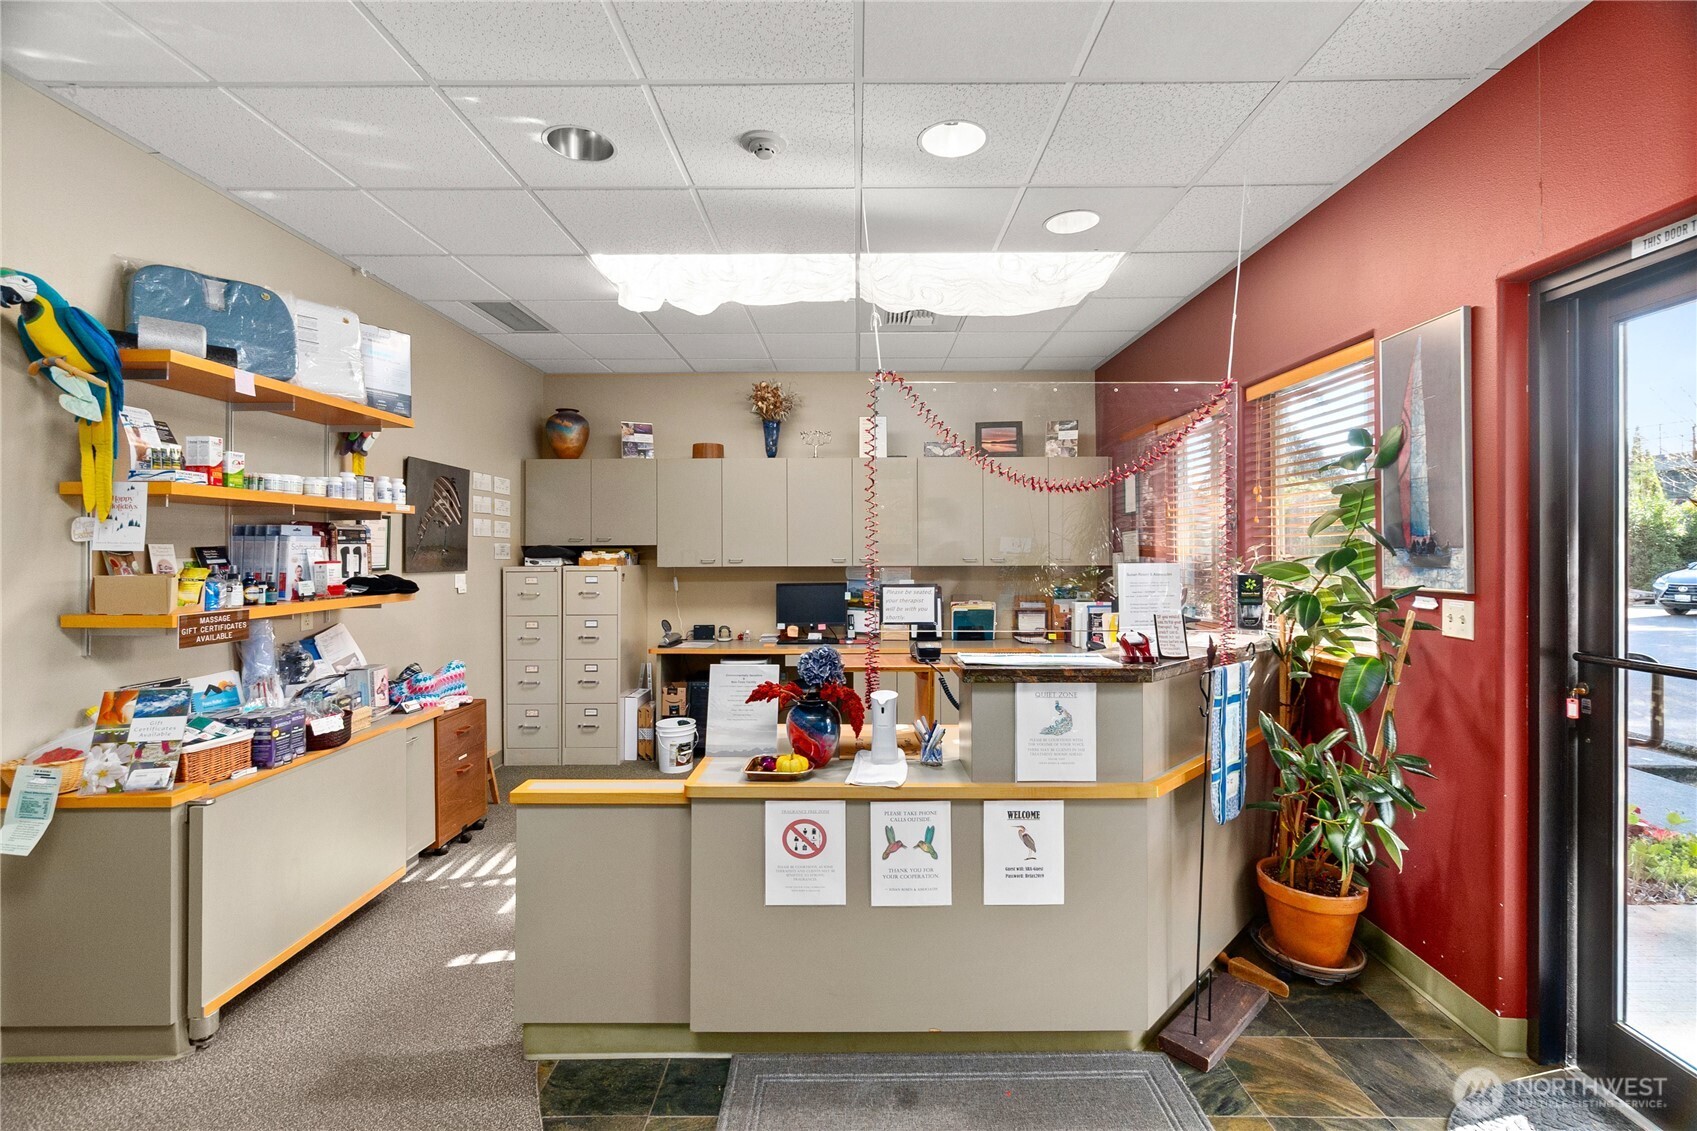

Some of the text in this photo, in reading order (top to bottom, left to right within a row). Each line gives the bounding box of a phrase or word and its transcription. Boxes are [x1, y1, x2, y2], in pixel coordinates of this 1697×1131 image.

[1643, 234, 1661, 249] THIS
[1665, 224, 1688, 241] DOOR
[200, 615, 230, 624] MASSAGE
[181, 622, 247, 636] GIFT CERTIFICATES
[196, 632, 233, 643] AVAILABLE
[1007, 811, 1040, 819] WELCOME
